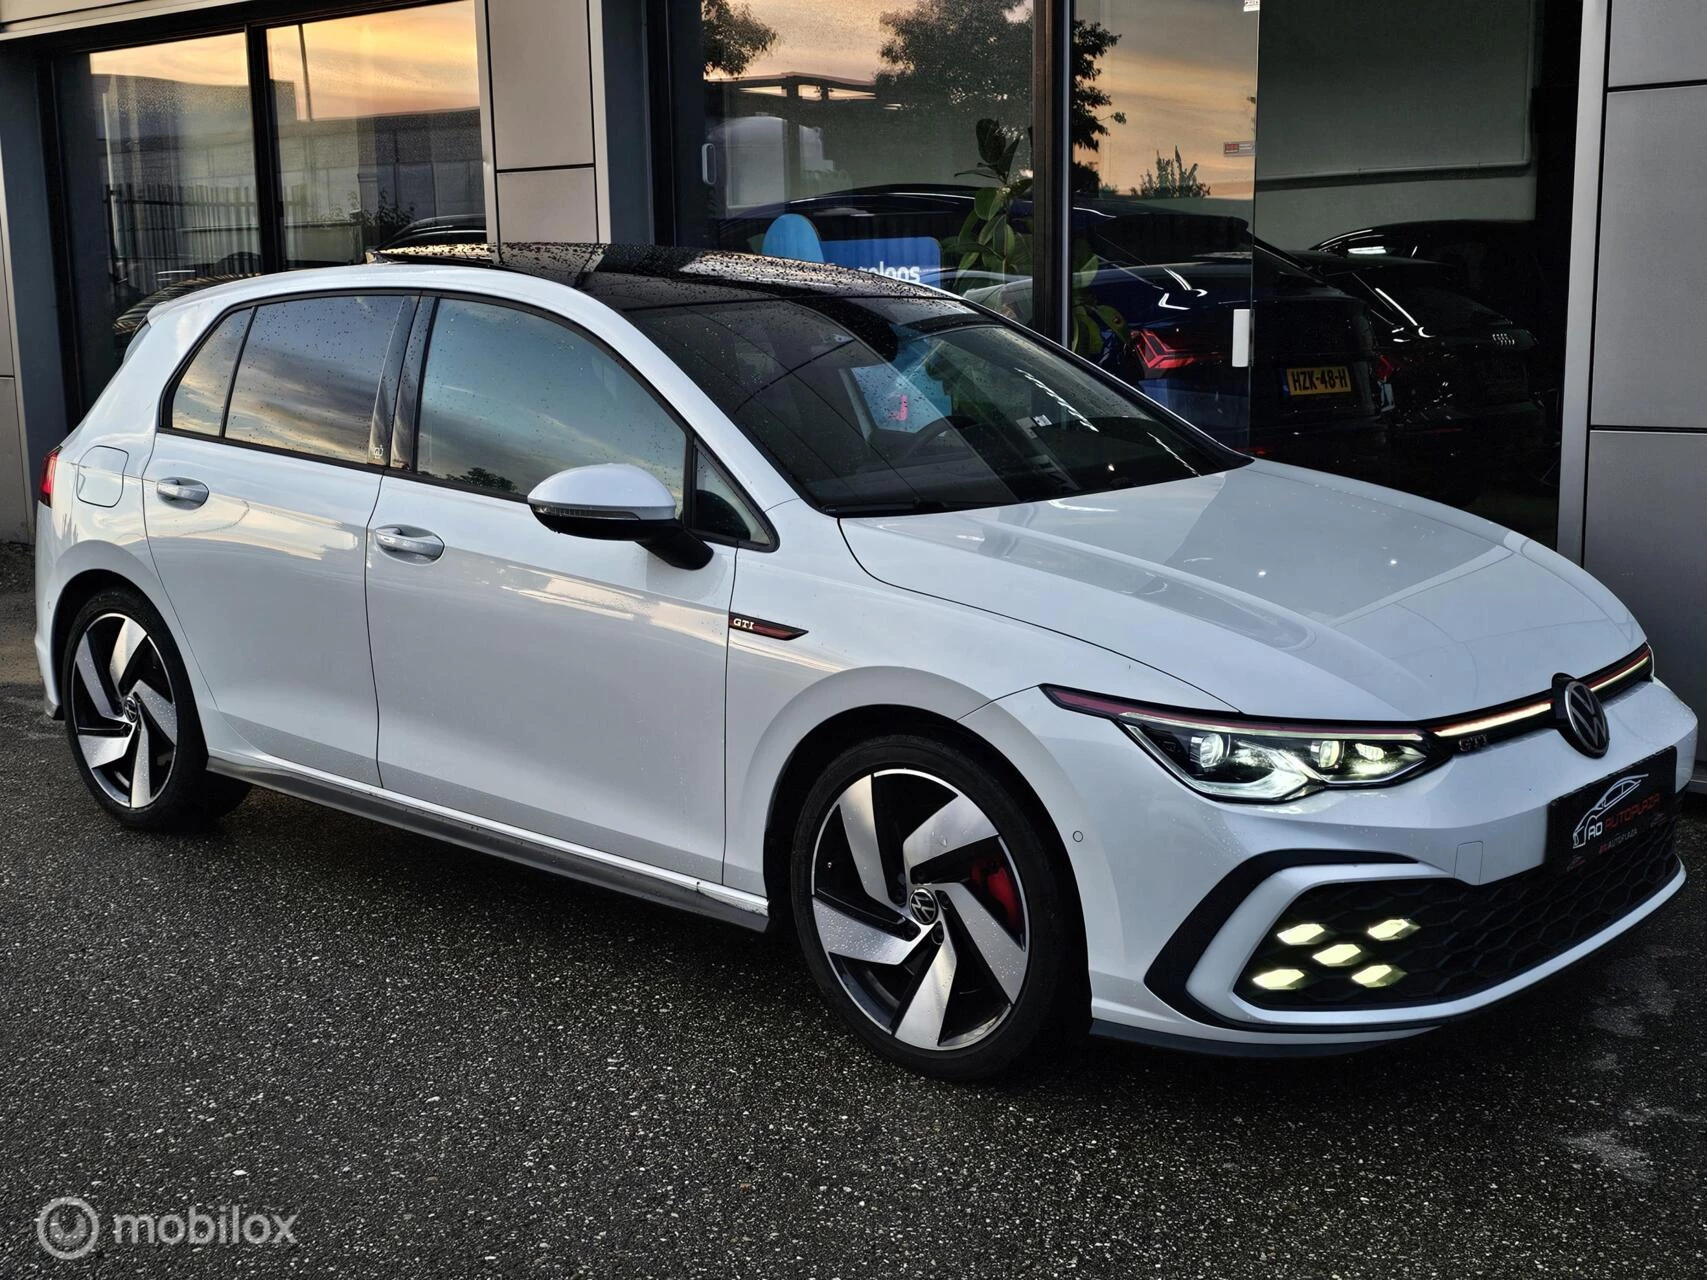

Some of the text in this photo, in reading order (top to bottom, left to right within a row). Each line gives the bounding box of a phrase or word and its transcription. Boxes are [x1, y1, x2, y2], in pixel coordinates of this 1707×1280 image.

[1291, 367, 1349, 392] HZK-48-H
[733, 617, 755, 631] GTI
[1457, 733, 1488, 753] GTI
